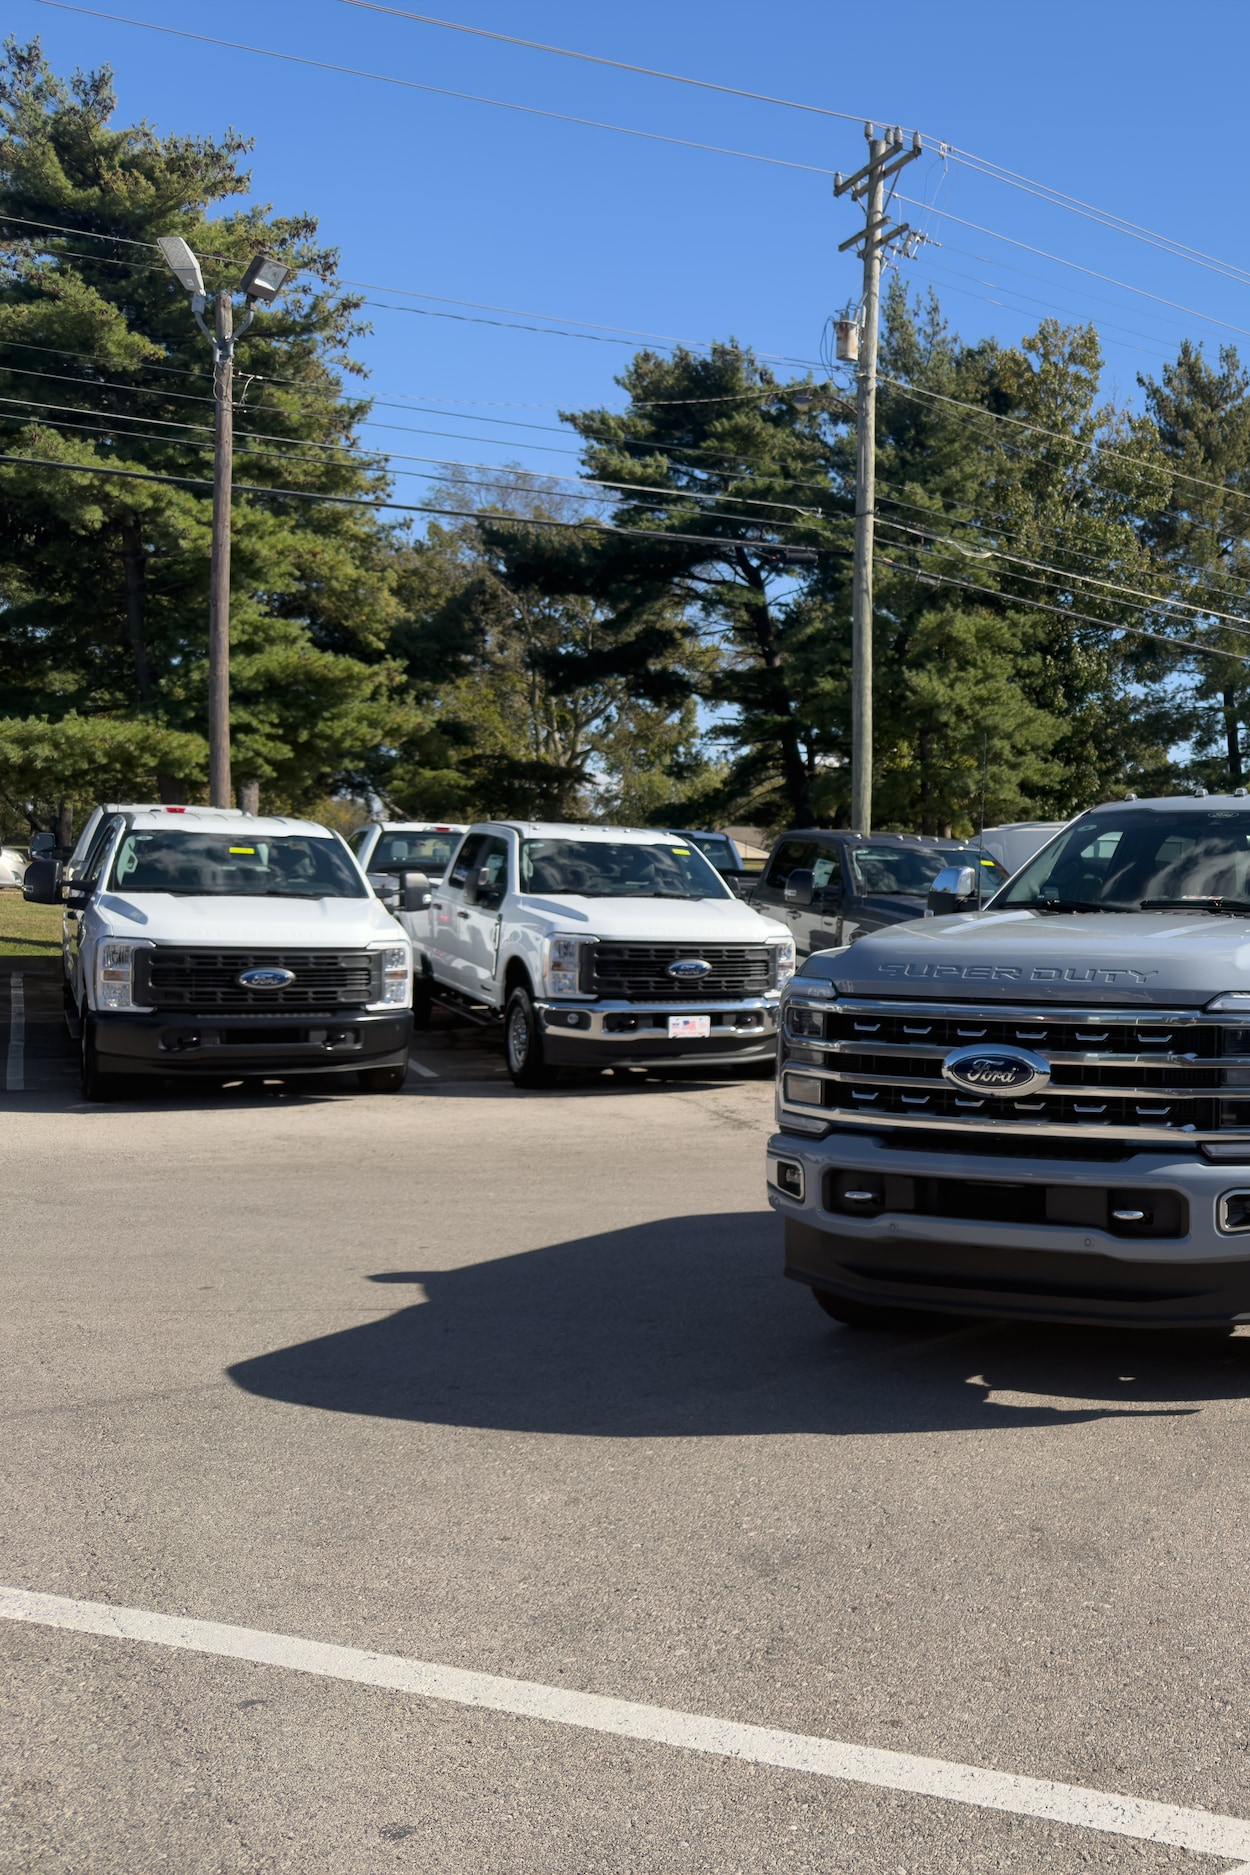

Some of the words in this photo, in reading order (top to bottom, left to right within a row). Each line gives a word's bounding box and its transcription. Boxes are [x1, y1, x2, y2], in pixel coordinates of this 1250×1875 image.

[878, 963, 1022, 981] SUPER
[1029, 966, 1159, 984] DUTY
[966, 1058, 1017, 1083] Ford
